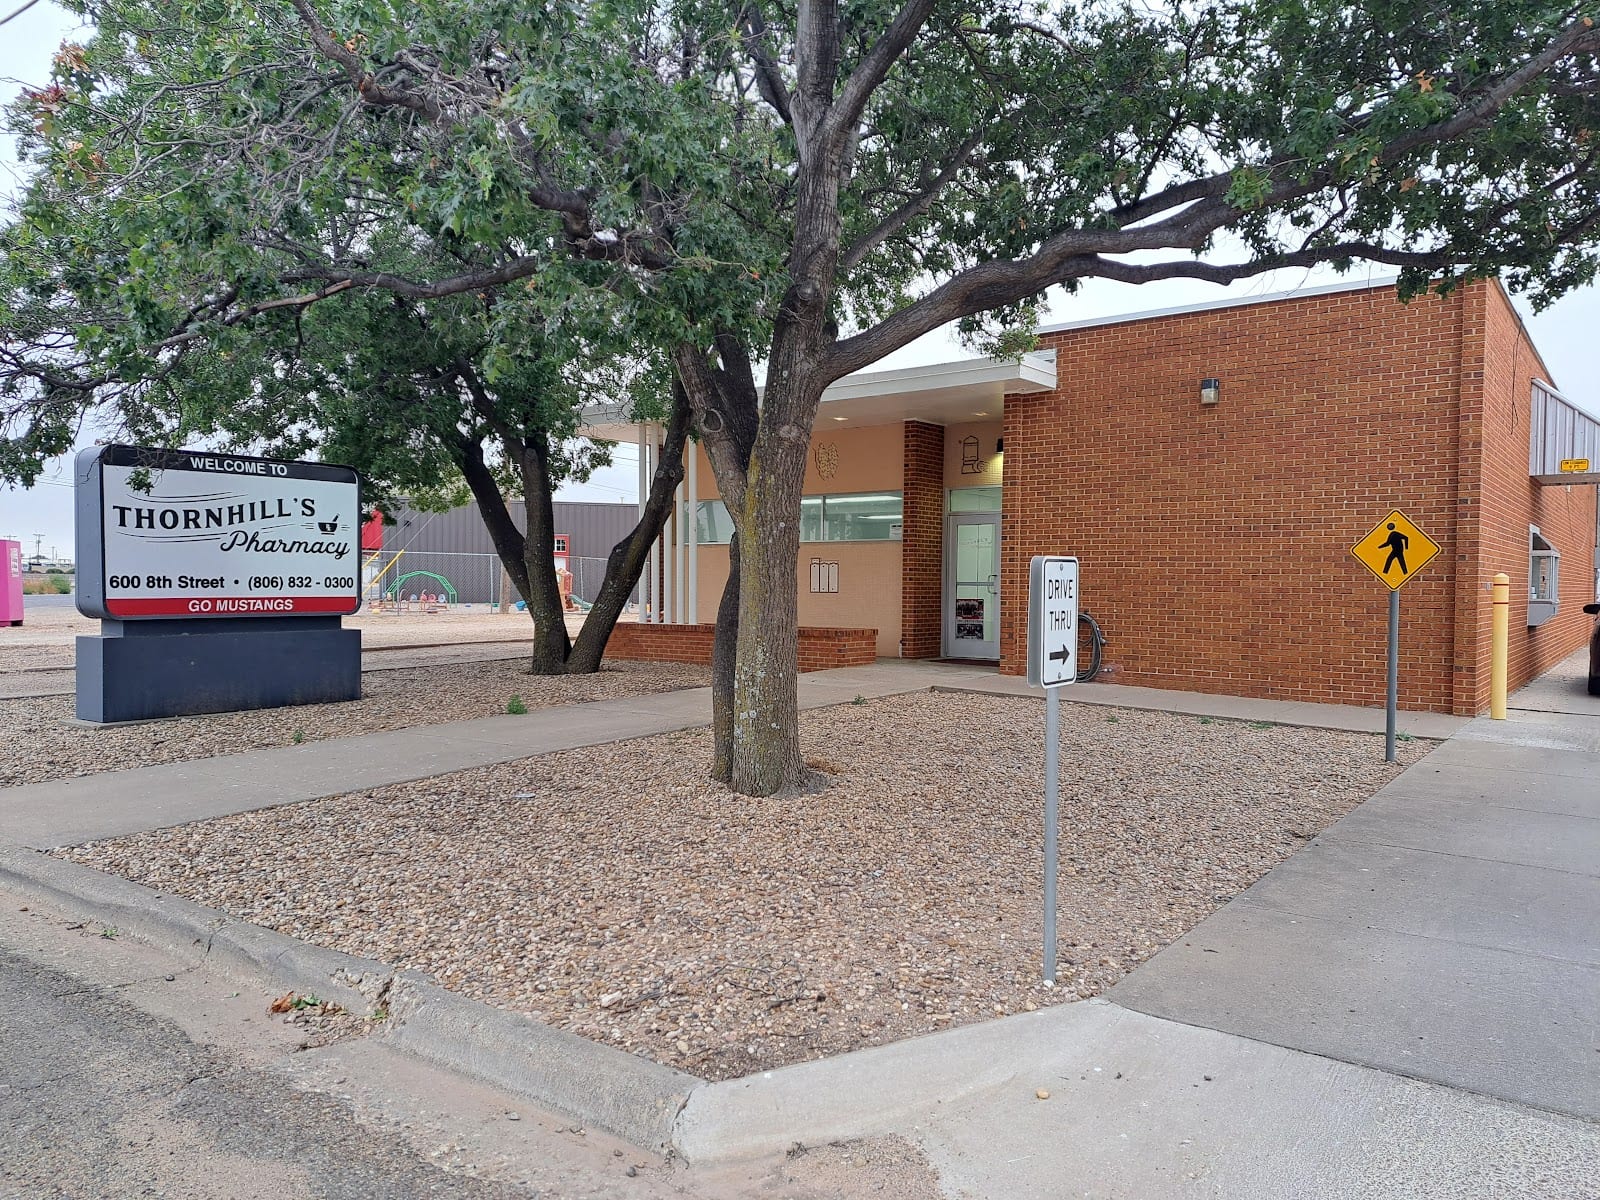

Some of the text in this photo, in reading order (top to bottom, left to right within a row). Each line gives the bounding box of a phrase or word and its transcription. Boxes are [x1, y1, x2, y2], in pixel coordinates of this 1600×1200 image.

[190, 456, 288, 476] WELCOME TO
[112, 497, 316, 530] THORNHILL'S
[219, 530, 351, 560] Pharmacy
[109, 575, 141, 589] 600
[146, 575, 172, 589] 8th
[178, 575, 225, 589] Street
[248, 575, 284, 591] (806)
[288, 575, 312, 588] 832
[324, 576, 354, 589] 0300
[1048, 579, 1073, 599] DRIVE
[188, 598, 294, 612] GO MUSTANGS
[1049, 610, 1072, 631] THRU
